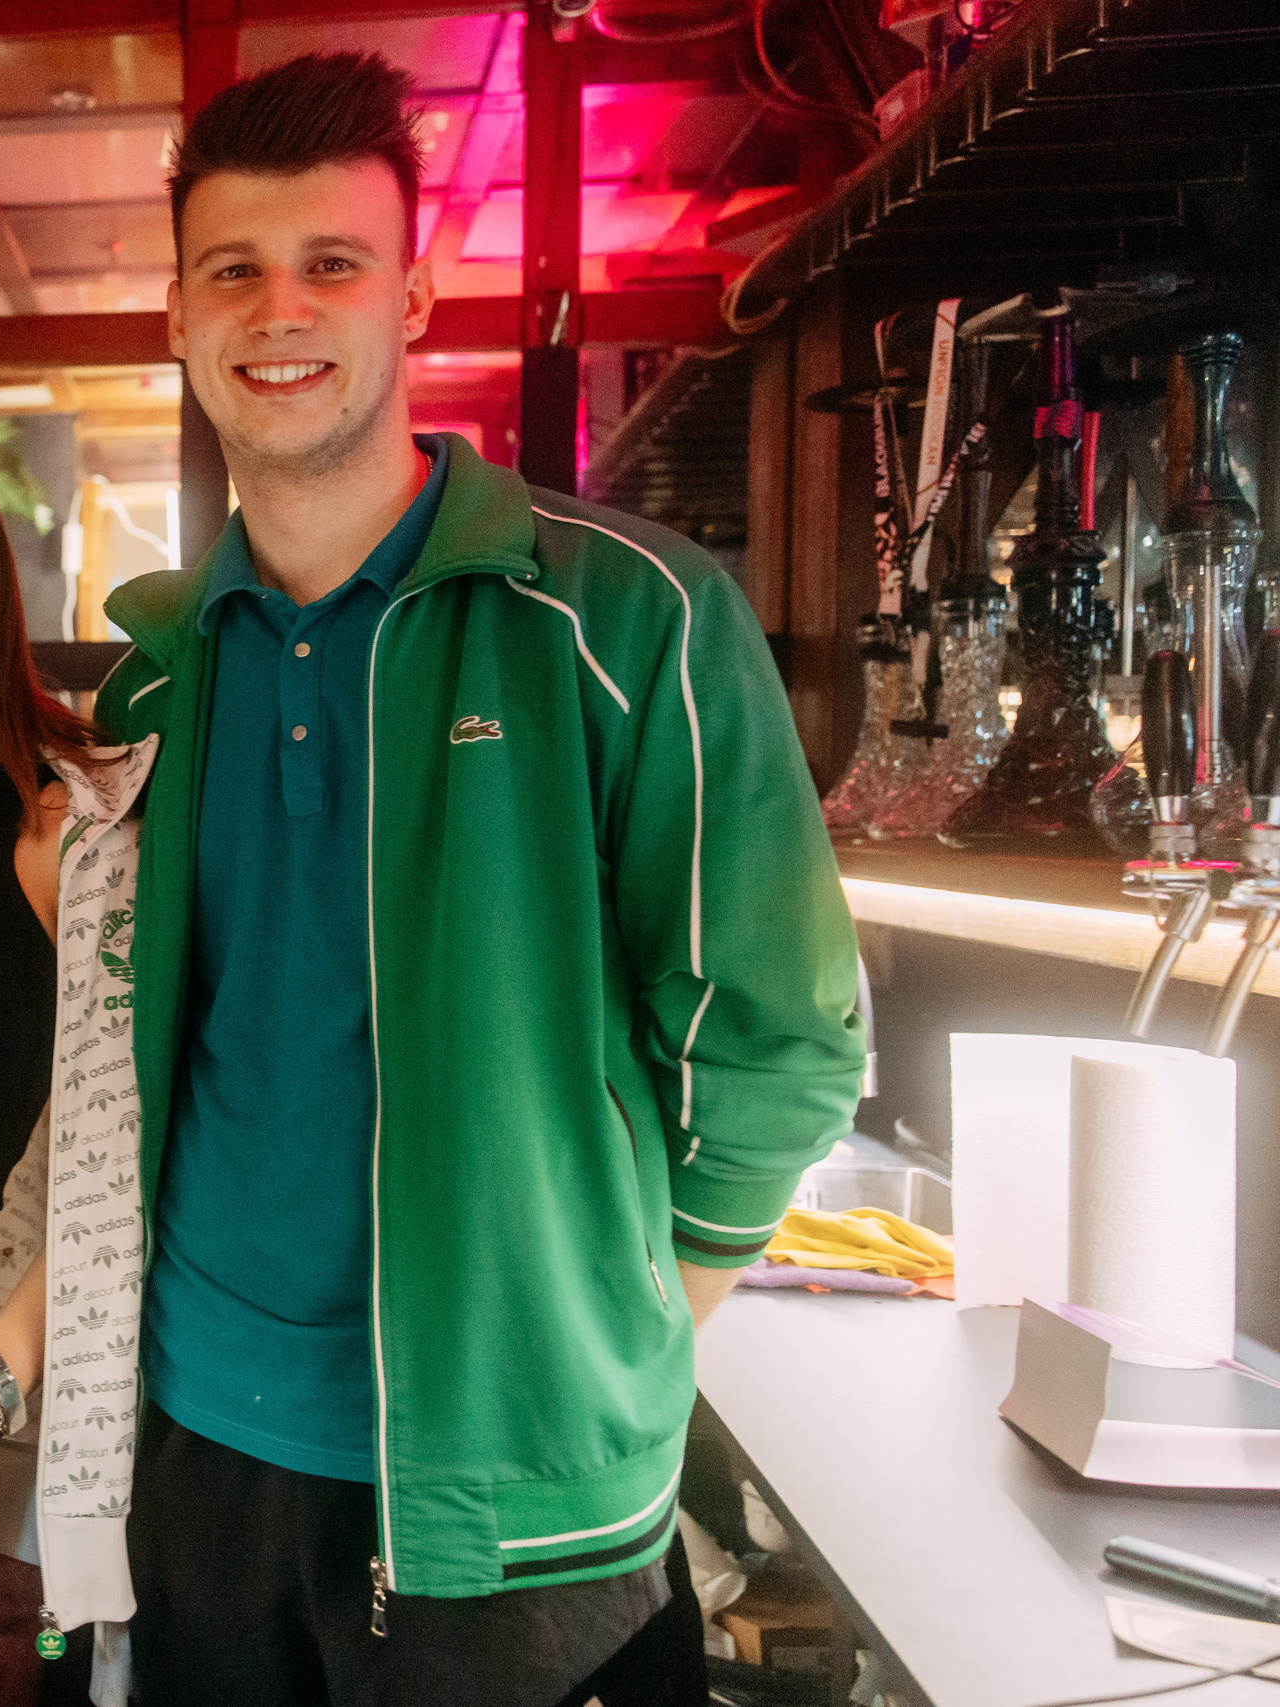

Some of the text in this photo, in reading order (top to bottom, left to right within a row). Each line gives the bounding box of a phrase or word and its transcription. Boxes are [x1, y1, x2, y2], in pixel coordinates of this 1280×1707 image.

[66, 886, 107, 909] adidas
[88, 1055, 132, 1079] adidas
[64, 1191, 108, 1211] adidas
[95, 1216, 136, 1235] adidas
[61, 1350, 106, 1367] adidas
[91, 1377, 134, 1394] adidas
